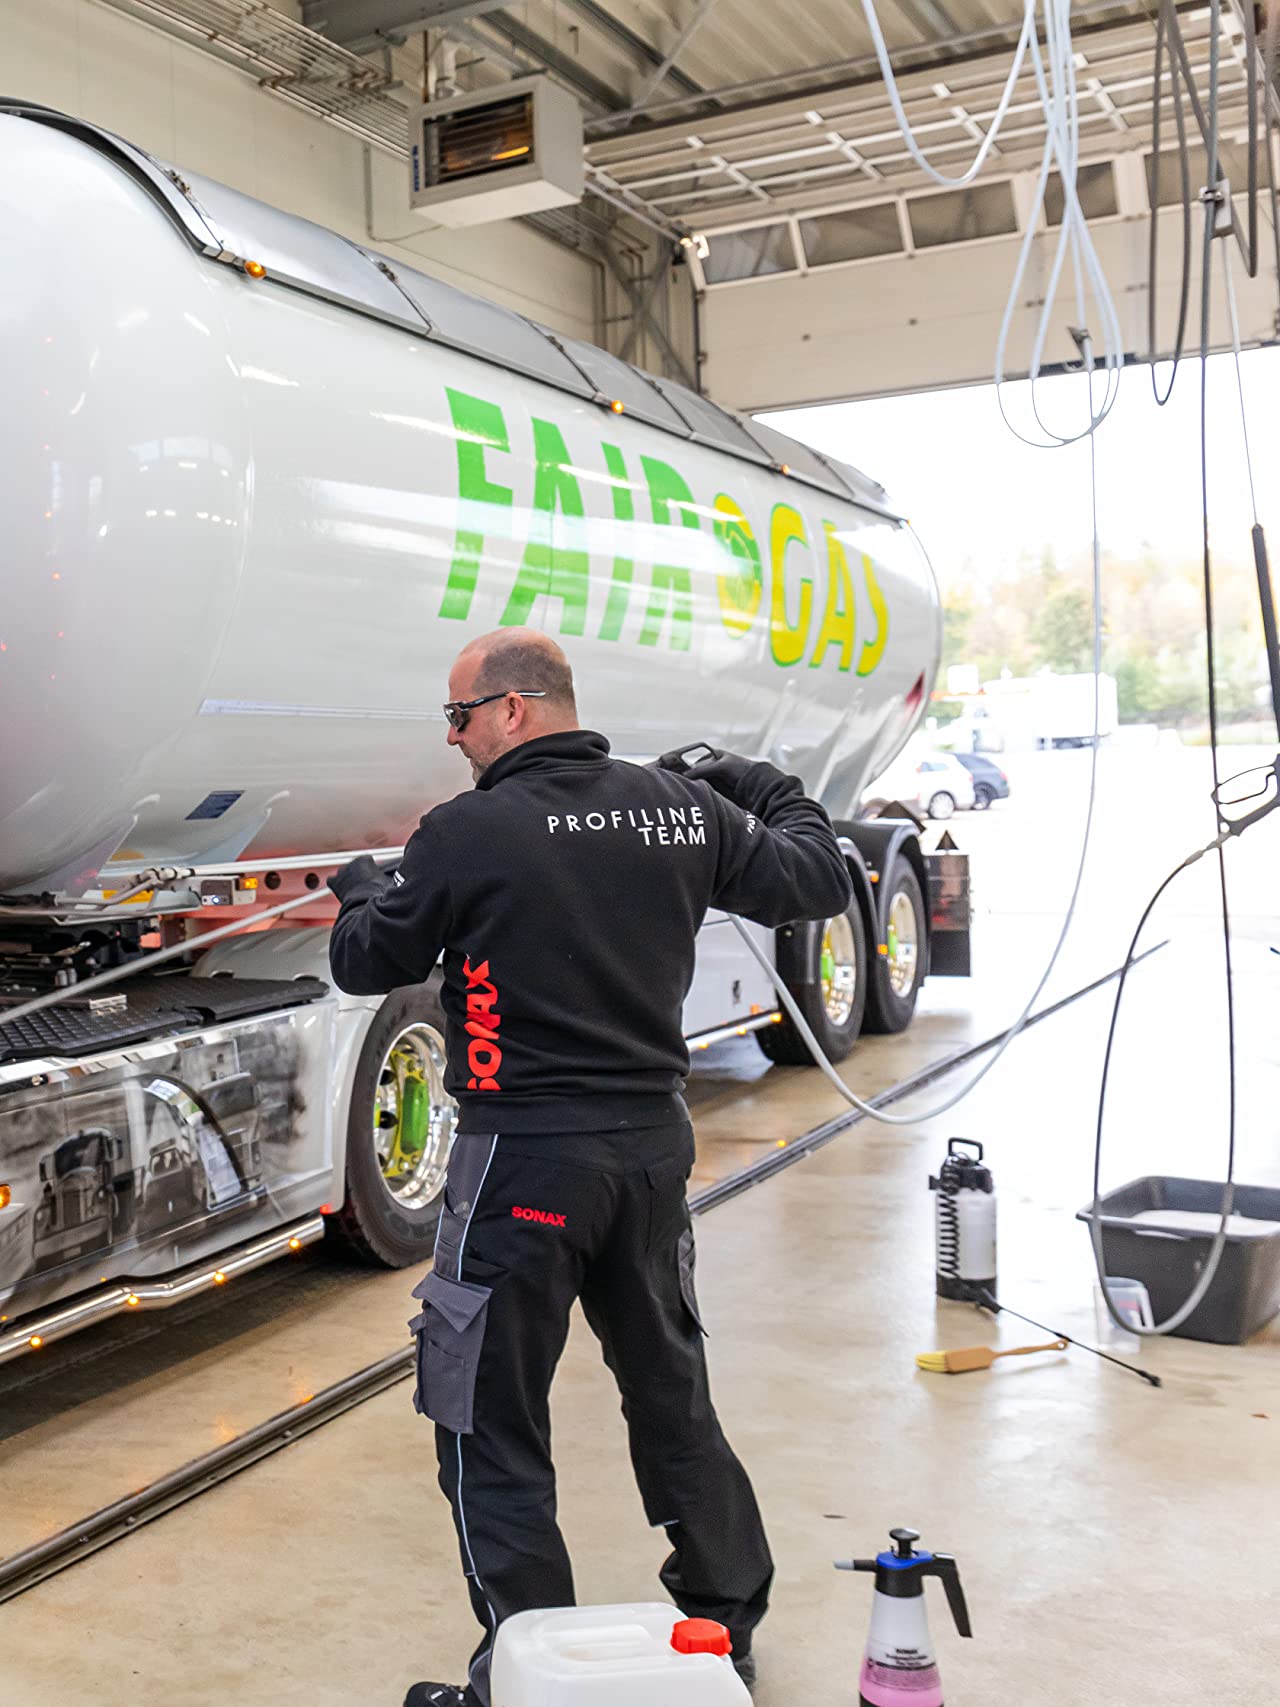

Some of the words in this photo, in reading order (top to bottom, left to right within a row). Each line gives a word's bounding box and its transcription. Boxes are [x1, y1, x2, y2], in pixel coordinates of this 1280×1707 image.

[439, 387, 701, 651] FAIR
[547, 807, 704, 833] PROFILINE
[638, 826, 706, 846] TEAM
[511, 1206, 567, 1227] SONAX
